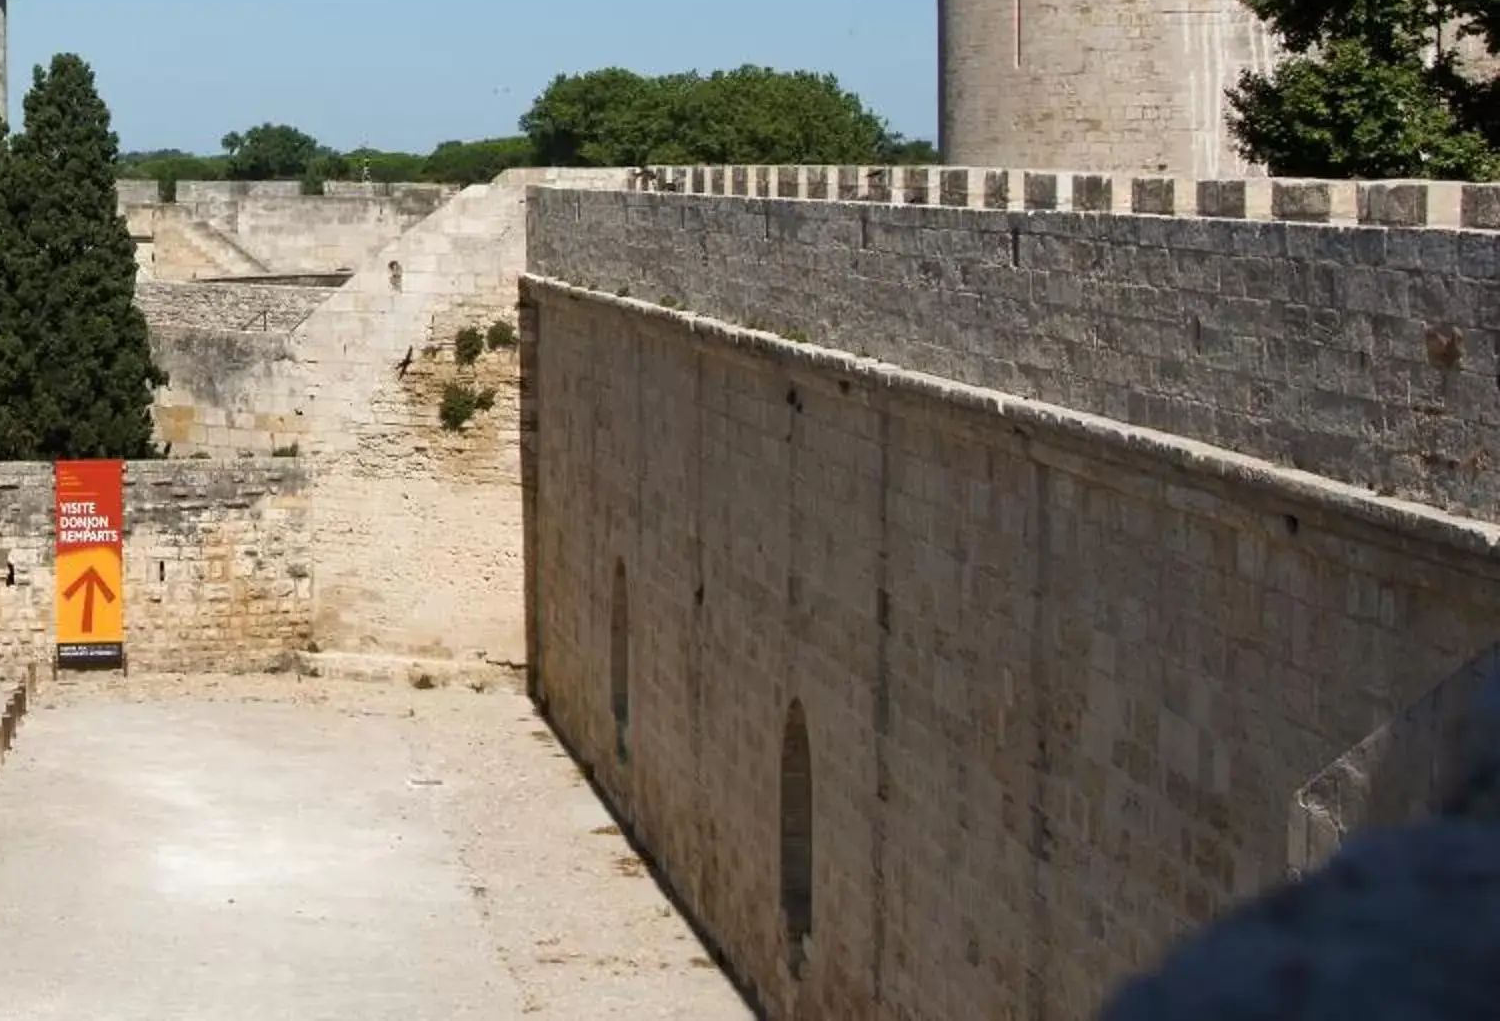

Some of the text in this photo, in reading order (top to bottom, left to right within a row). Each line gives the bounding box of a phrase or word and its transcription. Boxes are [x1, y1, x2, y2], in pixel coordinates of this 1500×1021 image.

[60, 502, 96, 513] VISITE
[60, 516, 109, 530] DONJON
[60, 530, 118, 542] REMPARTS
